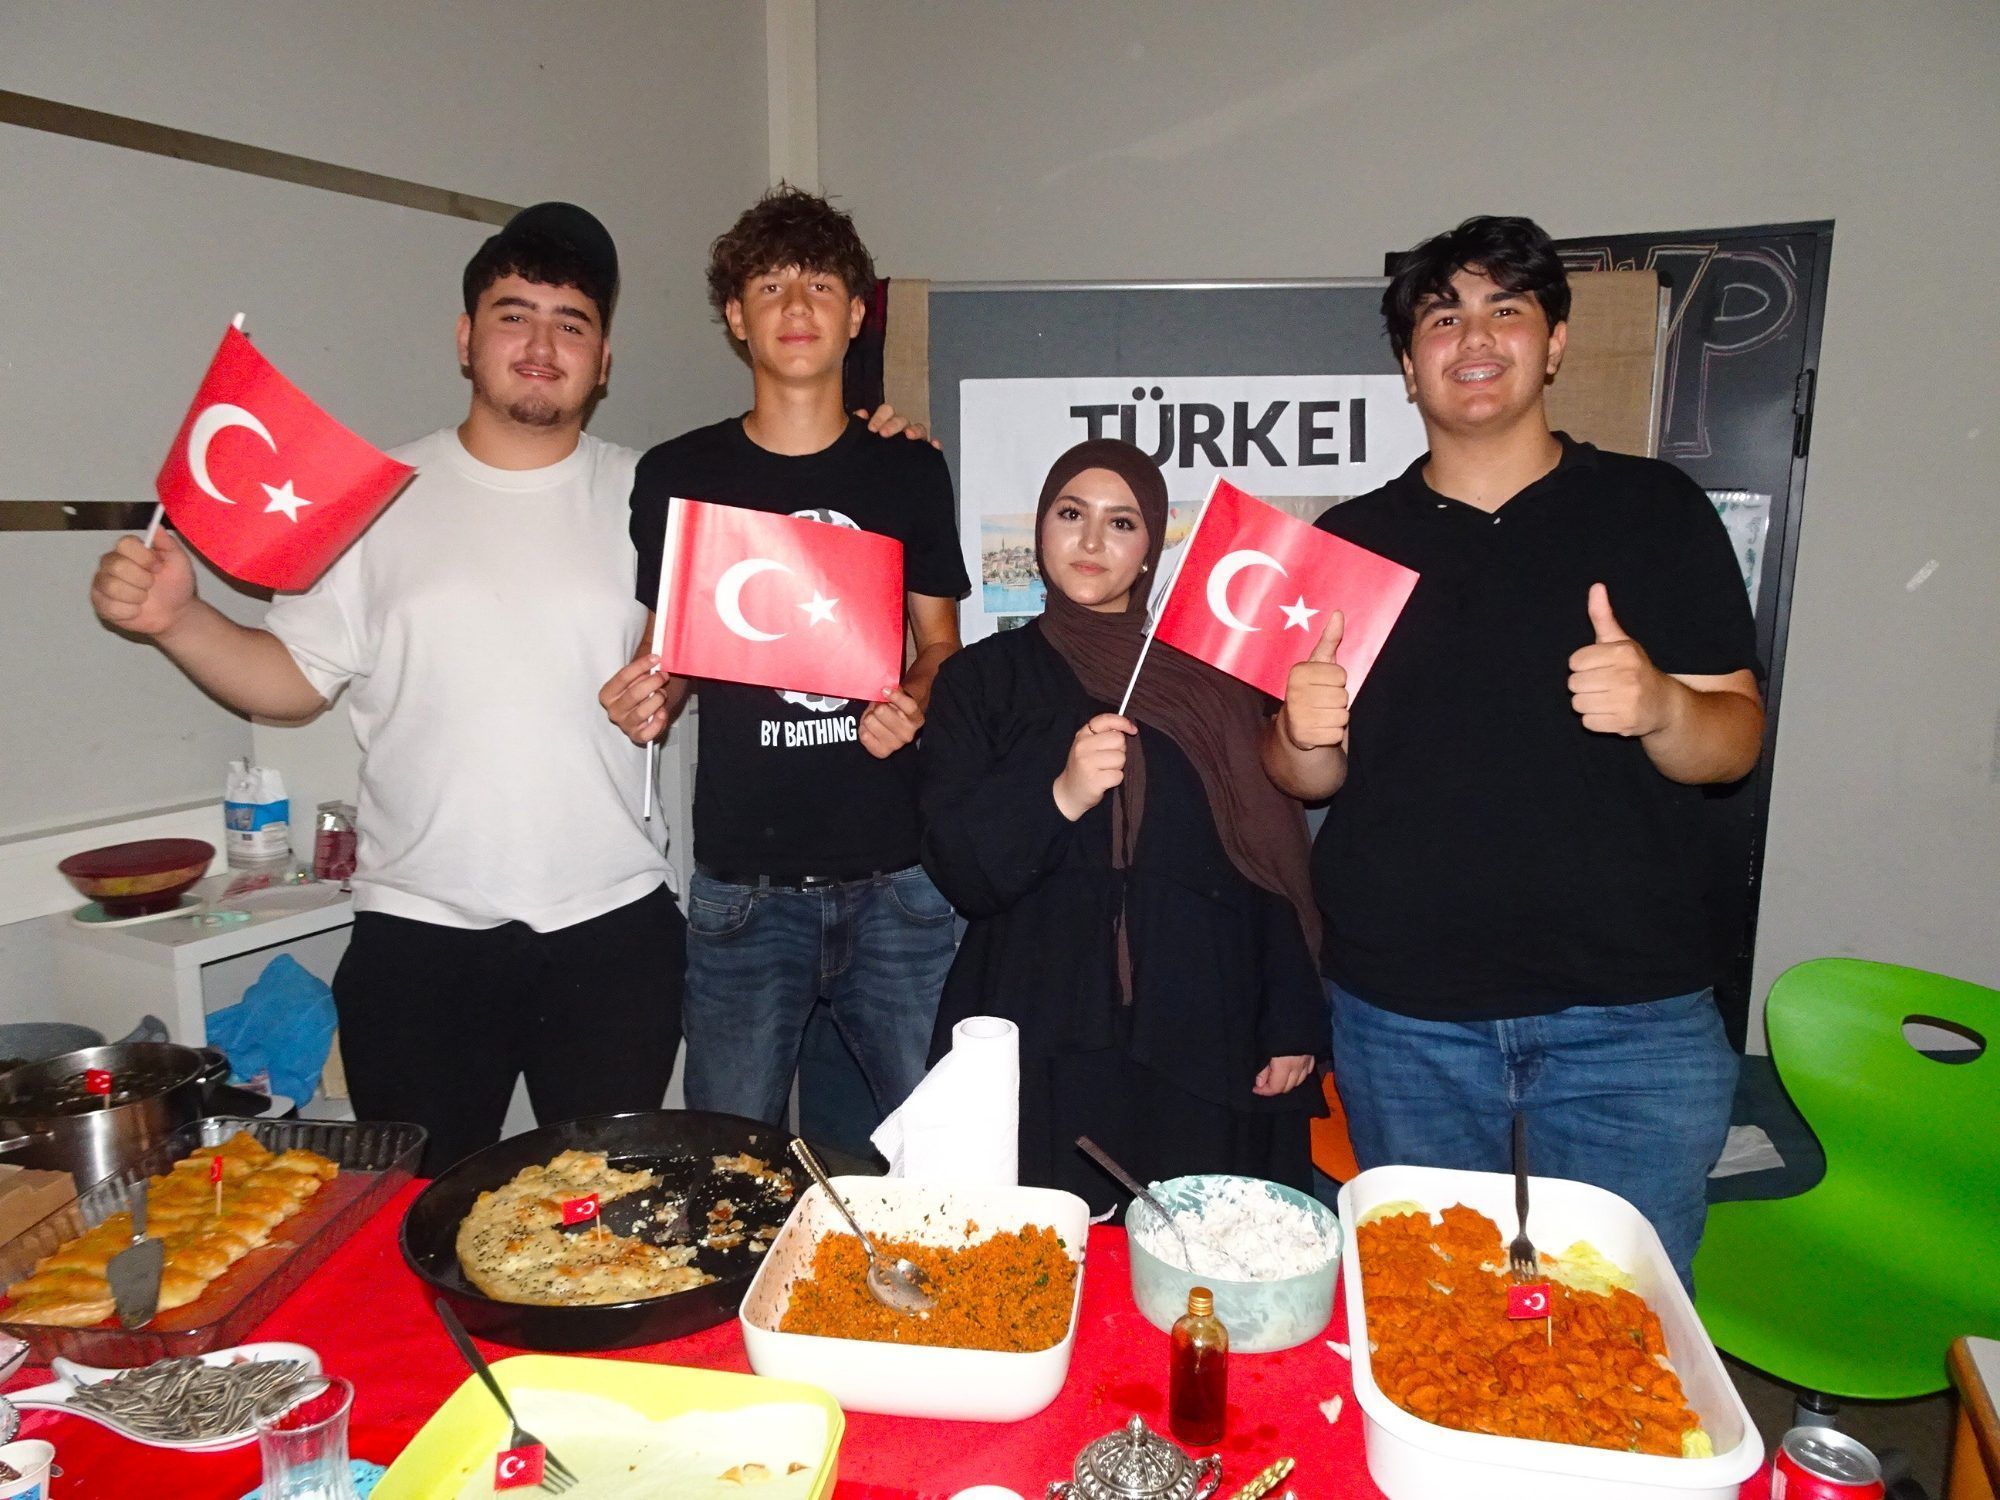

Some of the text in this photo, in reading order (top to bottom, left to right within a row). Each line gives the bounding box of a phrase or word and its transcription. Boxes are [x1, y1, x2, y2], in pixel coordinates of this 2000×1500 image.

[1070, 386, 1366, 468] TÜRKEI
[761, 715, 858, 748] BY BATHING
